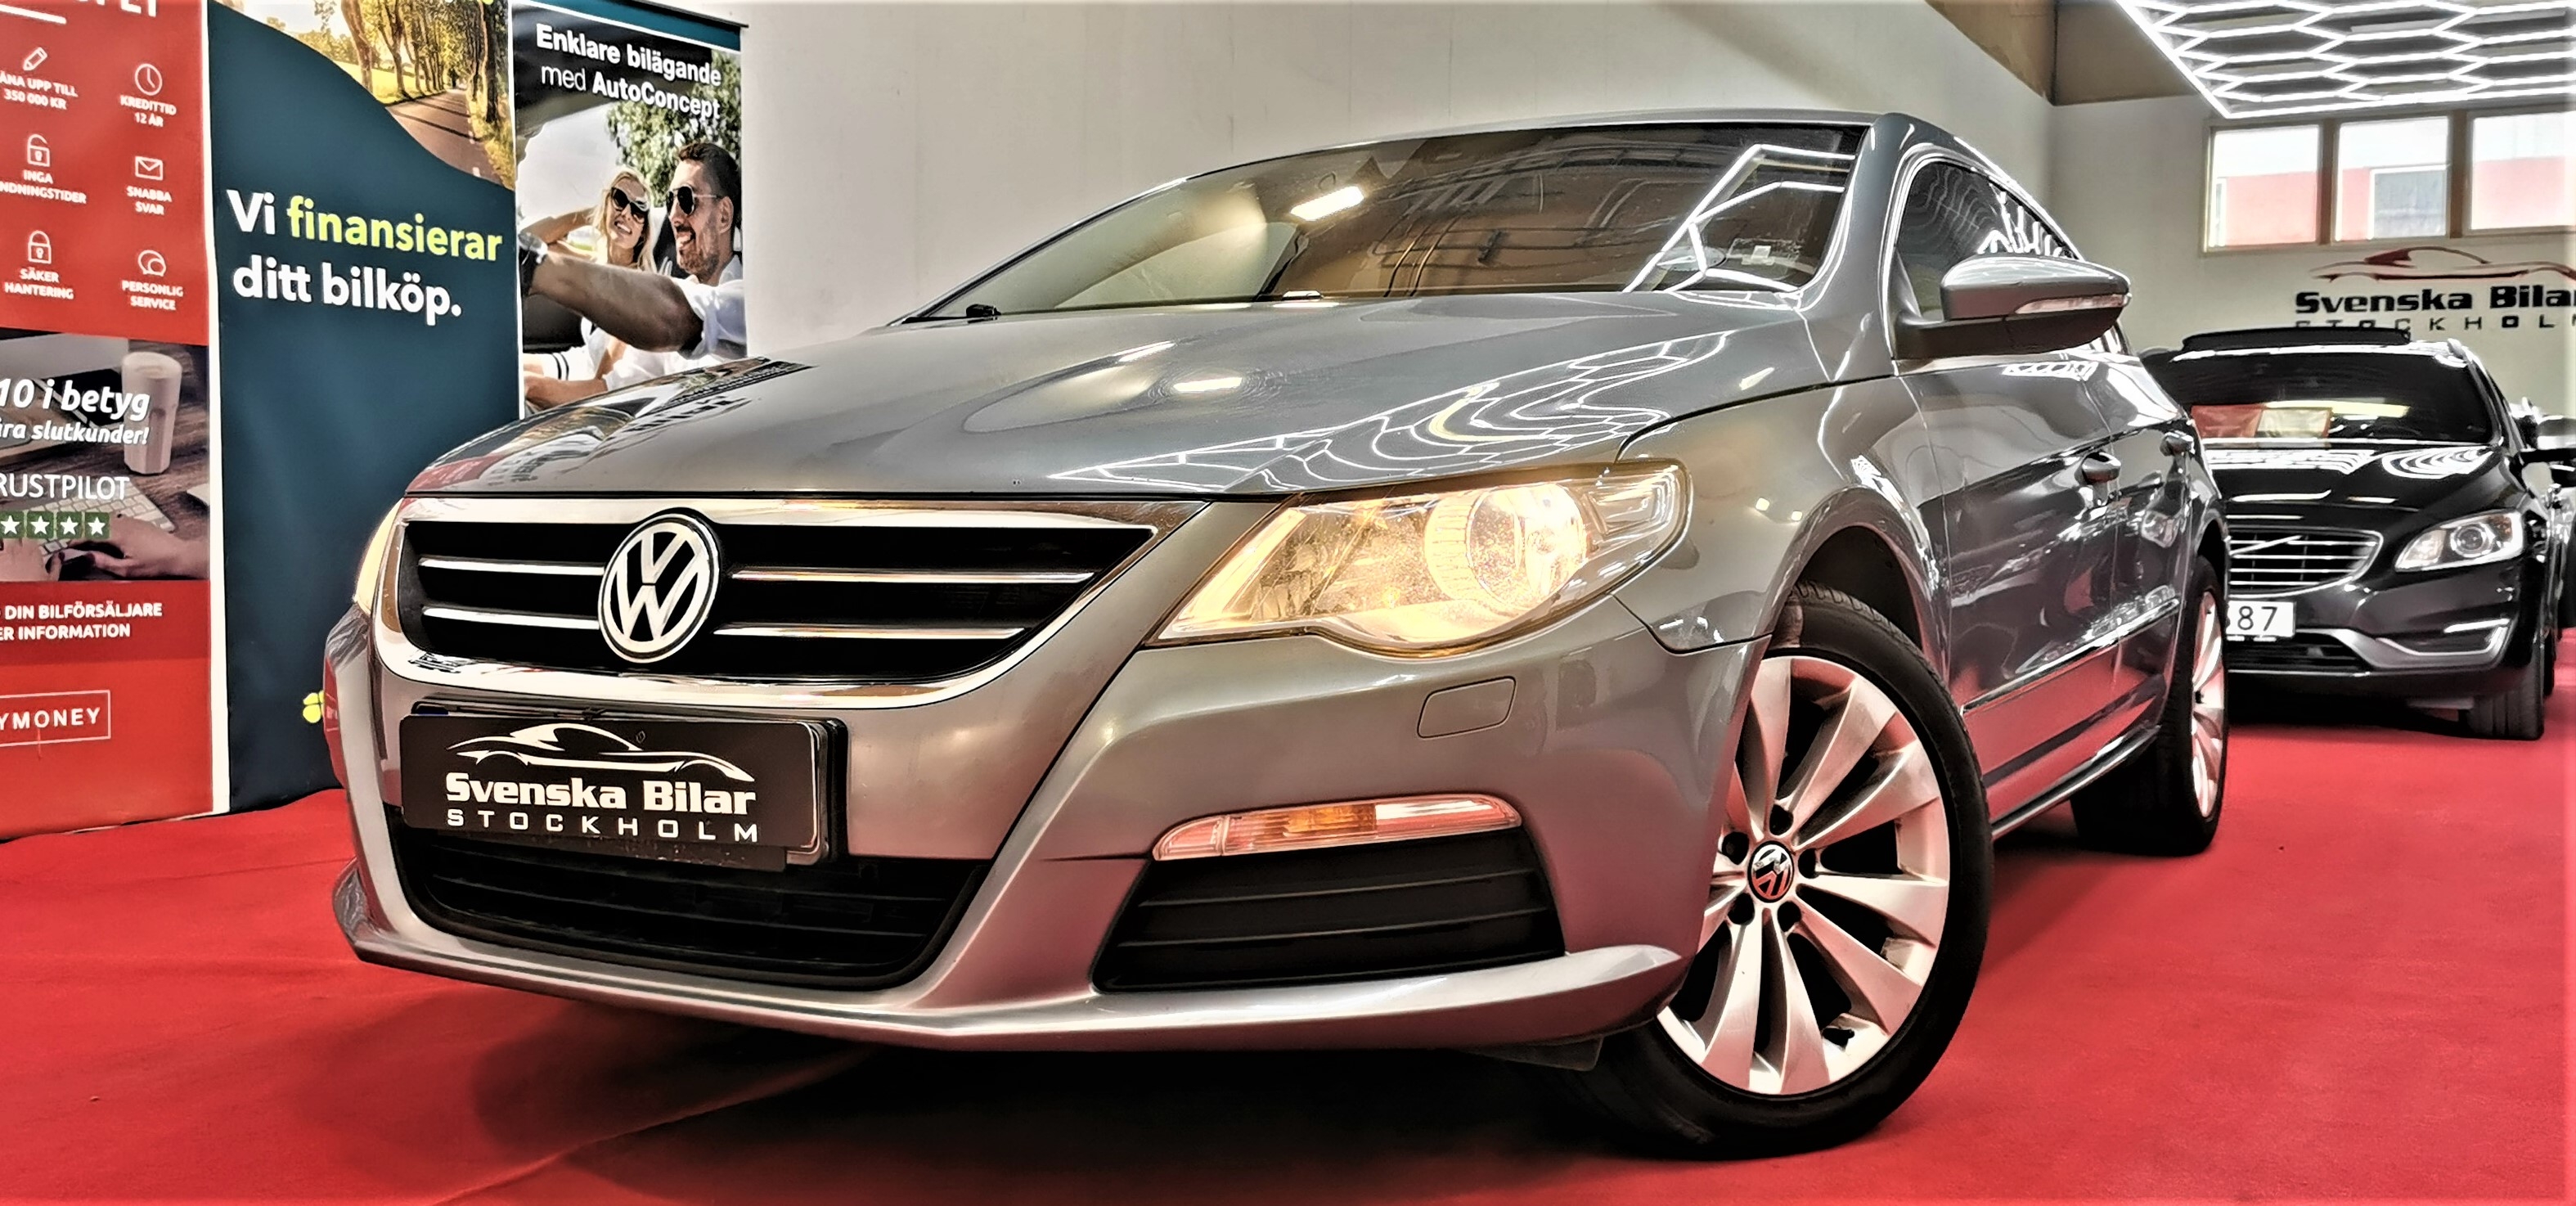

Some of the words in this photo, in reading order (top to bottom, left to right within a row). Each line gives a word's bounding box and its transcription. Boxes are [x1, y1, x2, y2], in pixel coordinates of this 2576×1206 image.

[536, 23, 621, 65] Enklare
[627, 43, 722, 87] bilägande
[27, 78, 52, 92] UPP
[53, 82, 79, 97] TILL
[541, 65, 587, 92] med
[592, 71, 721, 119] AutoConcept
[4, 88, 25, 102] 350
[27, 92, 48, 107] 000
[50, 97, 67, 110] KR
[120, 95, 177, 115] KREDITTID
[135, 112, 147, 124] 12
[148, 113, 164, 128] ÅR
[23, 169, 53, 184] INGA
[126, 186, 173, 203] SNABBA
[135, 200, 164, 216] SVAR
[227, 189, 276, 235] Vi
[286, 196, 503, 261] finansierar
[20, 267, 60, 283] SÄKER
[4, 281, 74, 299] HANTERING
[121, 280, 184, 297] PERSONLIG
[233, 254, 312, 304] ditt
[321, 262, 462, 326] bilköp.
[2295, 288, 2472, 313] Svenska
[2489, 284, 2576, 308] Bila
[130, 295, 177, 311] SERVICE
[2295, 315, 2576, 332] TOCKHOL
[43, 379, 56, 409] i
[61, 380, 151, 421] betyg
[31, 420, 150, 445] slutkunder!
[5, 605, 34, 620] DIN
[38, 600, 163, 619] BILFÖRSÄLJARE
[2225, 605, 2278, 632] 87
[18, 623, 131, 641] INFORMATION
[445, 772, 627, 809] Svenska
[642, 780, 757, 816] Bilar
[447, 808, 758, 843] STOCKHOLM
